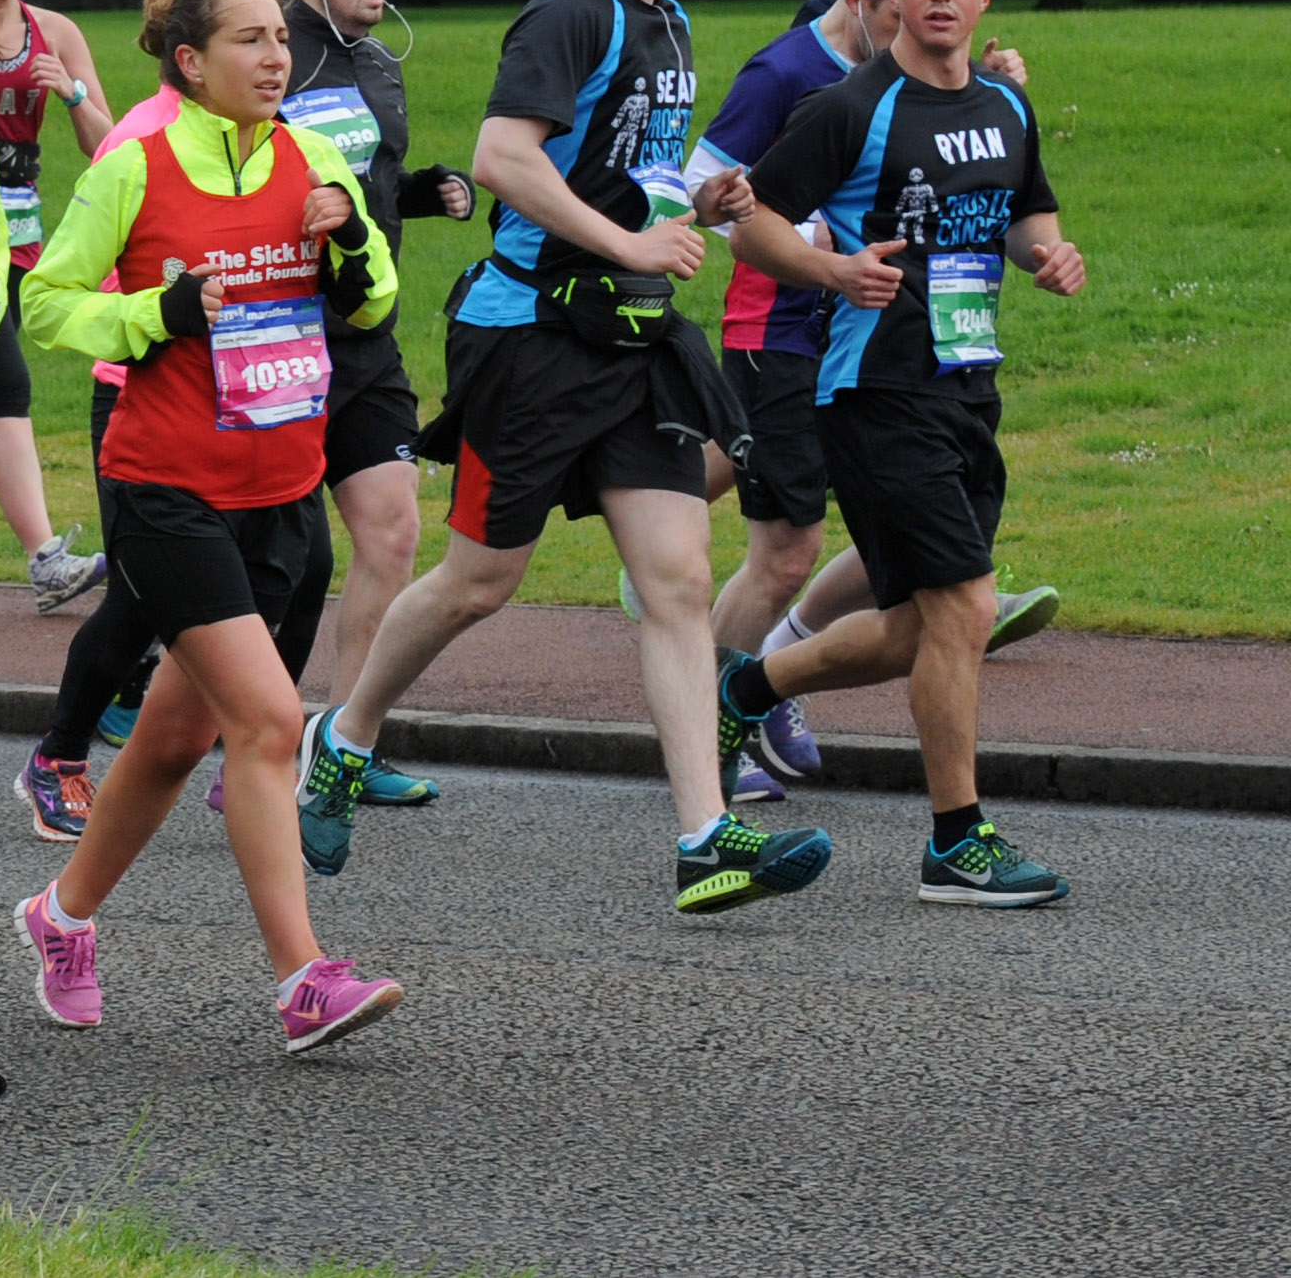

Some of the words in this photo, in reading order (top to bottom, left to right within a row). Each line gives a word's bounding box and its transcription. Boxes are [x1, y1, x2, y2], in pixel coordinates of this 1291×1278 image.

[934, 127, 1007, 165] RYAN
[204, 250, 247, 270] The
[250, 242, 297, 267] Sick
[246, 306, 293, 321] marathon
[241, 355, 323, 393] 10333
